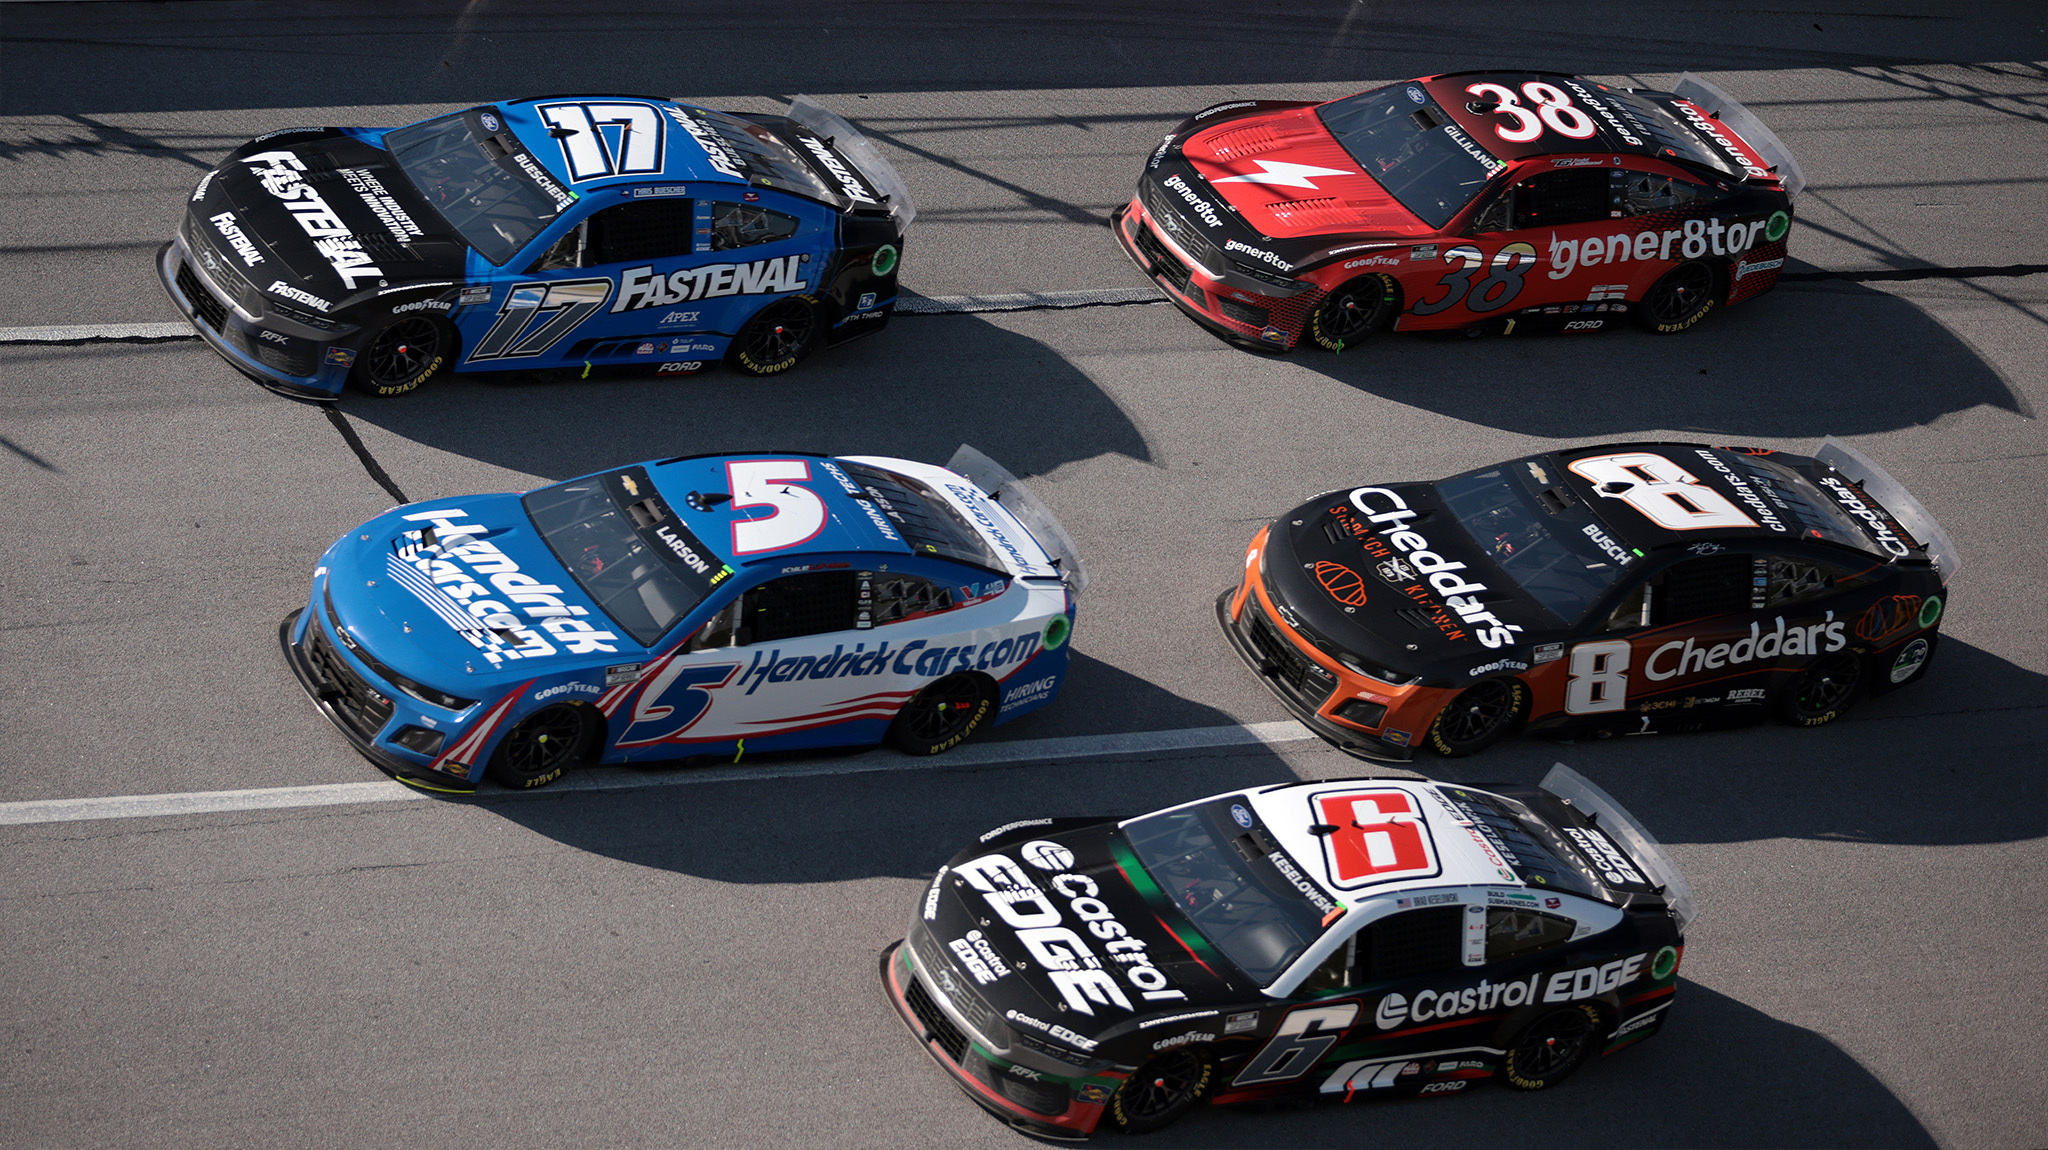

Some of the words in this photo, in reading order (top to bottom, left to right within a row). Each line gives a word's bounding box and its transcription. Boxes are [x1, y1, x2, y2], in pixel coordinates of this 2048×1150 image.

[1465, 81, 1597, 143] 38
[1564, 79, 1643, 146] gener8tor
[534, 101, 668, 185] 17
[664, 106, 744, 179] FASTENAL
[1443, 125, 1496, 171] GILLILAND
[1670, 99, 1769, 178] gener8tor
[513, 152, 568, 202] BUESCHER
[799, 136, 877, 204] FASTENAL
[240, 150, 384, 290] FASTENAL
[335, 168, 370, 194] MEETS
[359, 191, 409, 244] INNOVATION
[355, 168, 390, 197] WHERE
[379, 195, 424, 237] INDUSTRY
[1163, 174, 1223, 228] gener8tor
[209, 211, 263, 268] FASTENAL
[1224, 239, 1294, 272] gener8tor
[1343, 255, 1400, 271] GOODYEAR
[1548, 217, 1766, 280] gener8tor
[267, 280, 331, 313] FASTENAL
[608, 254, 808, 315] FASTENAL
[1411, 242, 1537, 316] 38
[392, 298, 452, 314] GOODYEAR
[464, 277, 614, 364] 17
[659, 311, 700, 325] APEX
[1564, 320, 1604, 330] FORD
[1658, 299, 1714, 332] GOODYEAR
[378, 356, 443, 396] GOODYEAR
[657, 361, 702, 373] FORD
[738, 350, 796, 375] GOODYEAR
[820, 461, 860, 498] TECHS
[1567, 452, 1761, 530] 8
[724, 459, 829, 556] 5
[855, 498, 899, 542] HIRING
[655, 525, 710, 574] LARSON
[1348, 487, 1524, 649] Cheddar's
[1581, 523, 1633, 565] BUSCH
[402, 508, 619, 654] Hendrick
[1469, 659, 1528, 678] GOODYEAR
[1644, 610, 1847, 682] Cheddar's
[534, 681, 601, 700] GOODYEAR
[1003, 675, 1056, 704] HIRING
[1564, 639, 1632, 715] 8
[1726, 687, 1766, 700] REBEL
[614, 661, 743, 749] 5
[930, 699, 990, 754] GOODYEAR
[1804, 709, 1837, 727] EAGLE
[525, 767, 562, 788] EAGLE
[1316, 790, 1433, 884] 6
[1562, 826, 1611, 871] Castrol
[1577, 826, 1645, 884] EDGE
[1268, 851, 1337, 914] KESELOWSK
[1486, 891, 1505, 899] BUILD
[1486, 897, 1540, 908] SUBMARINES.COM
[951, 853, 1135, 1017] EDGE
[973, 938, 1011, 978] Castrol
[1052, 873, 1189, 1001] Castrol
[948, 937, 999, 986] EDGE
[1411, 972, 1542, 1022] Castrol
[1543, 953, 1648, 1003] EDGE
[1015, 1012, 1050, 1032] Castrol
[1047, 1023, 1099, 1051] EDGE
[1152, 1031, 1216, 1051] GOODYEAR
[1229, 1000, 1360, 1089] 6
[1419, 1080, 1467, 1093] FORD
[1505, 1049, 1544, 1089] GOODYEAR
